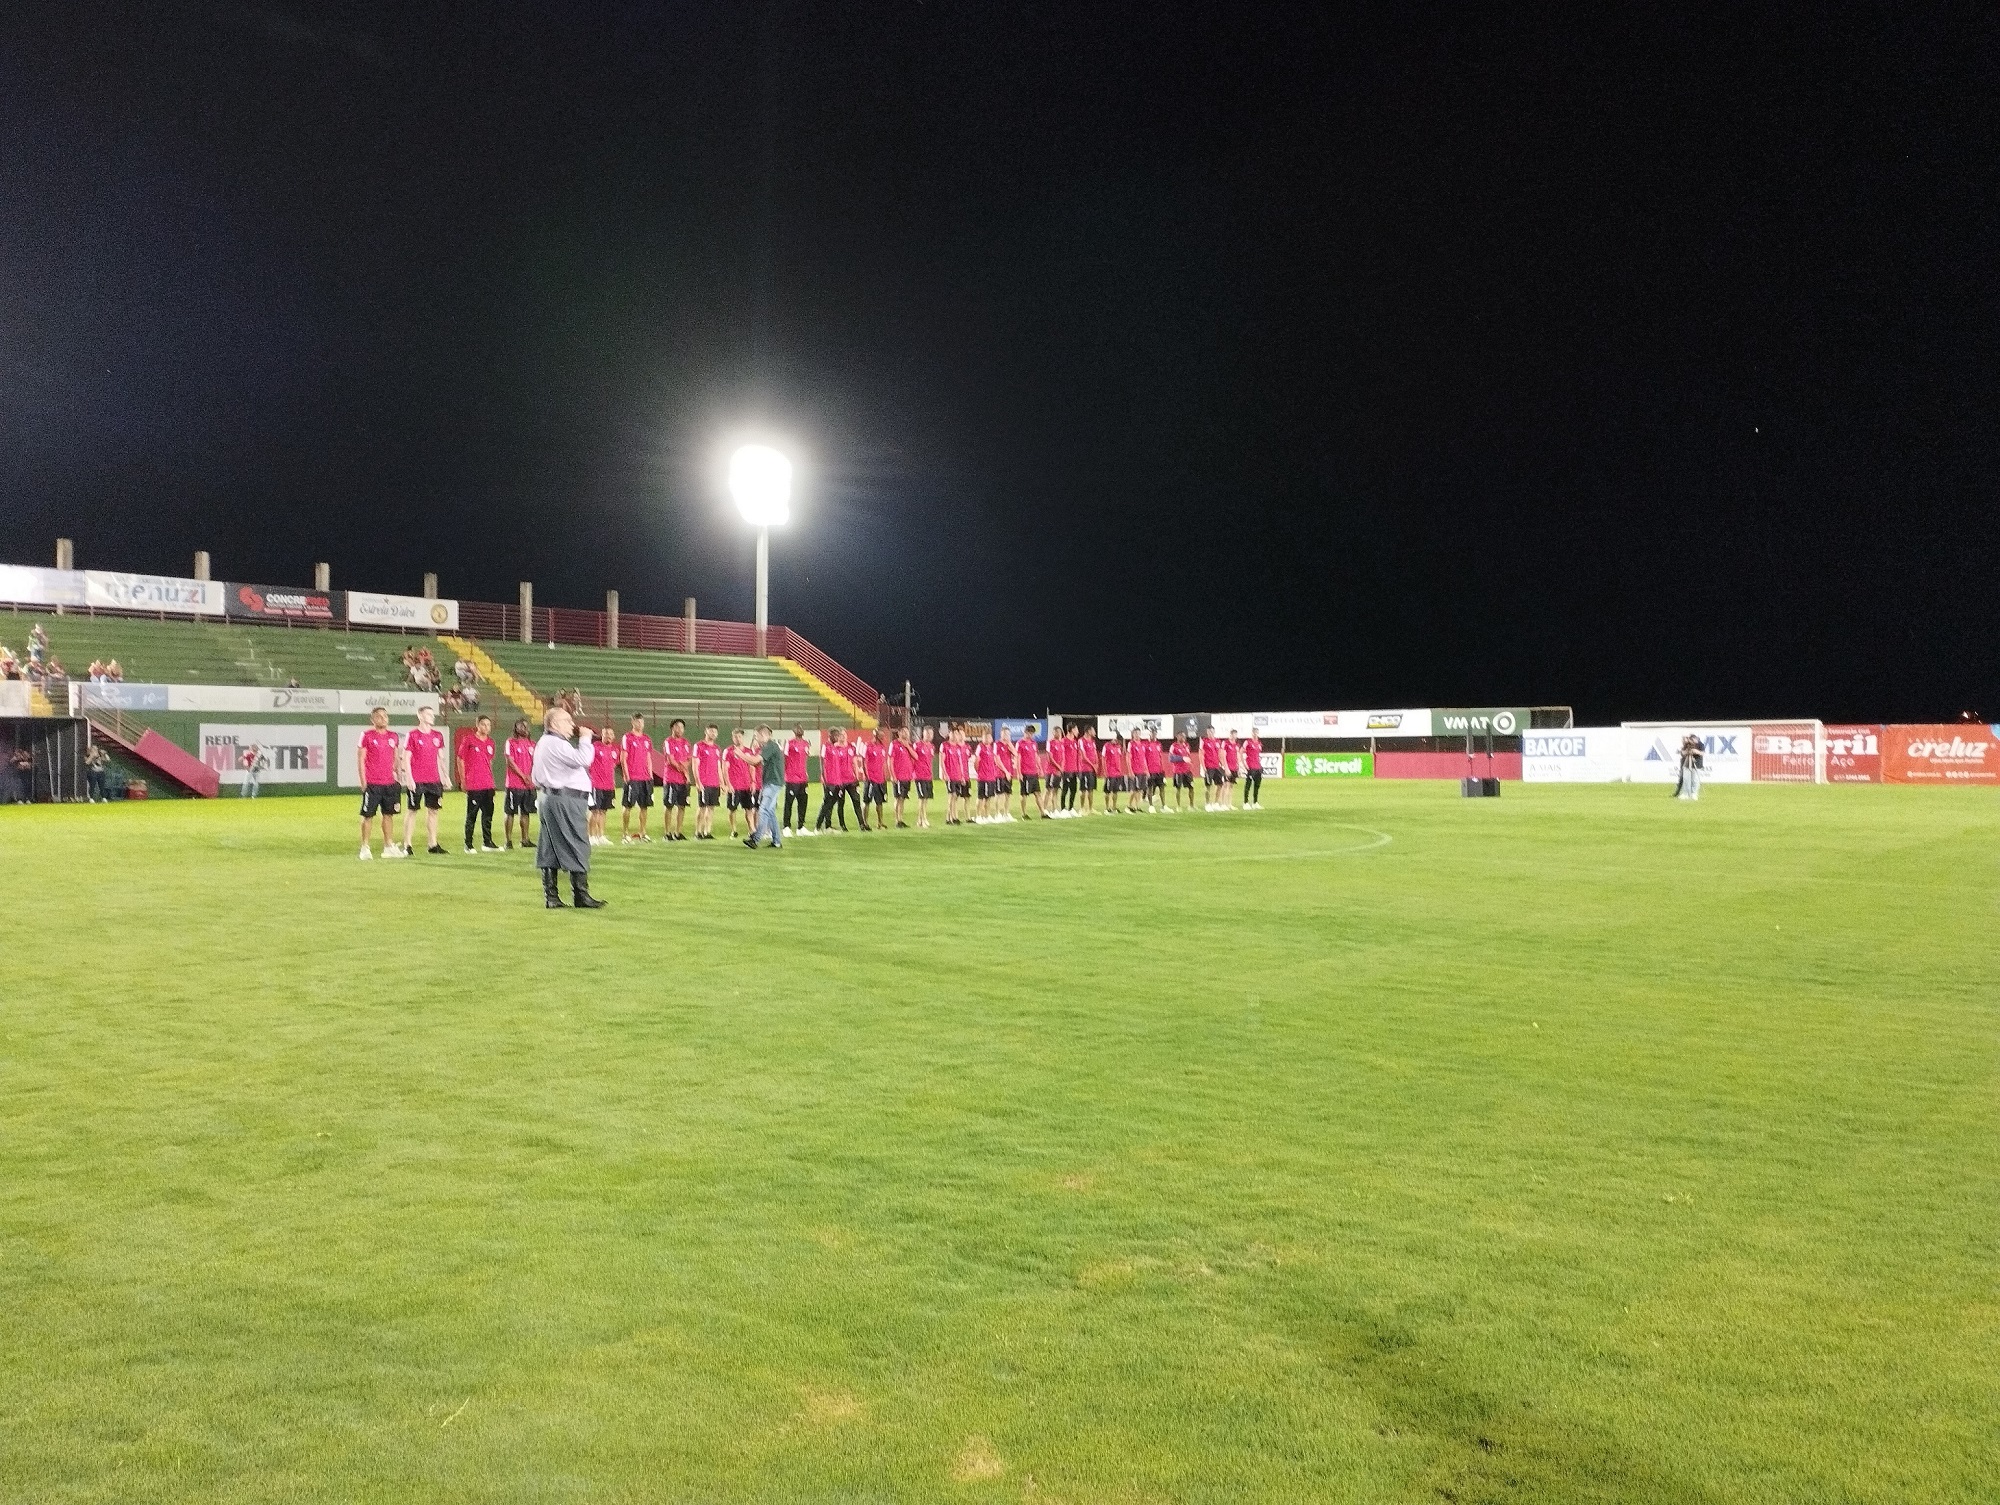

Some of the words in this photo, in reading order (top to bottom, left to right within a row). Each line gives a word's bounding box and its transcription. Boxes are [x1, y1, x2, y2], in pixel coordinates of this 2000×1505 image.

[205, 735, 239, 746] REDE
[1525, 738, 1584, 756] BAKOF
[1907, 736, 1989, 758] creluz
[205, 745, 325, 770] METRE
[1313, 757, 1363, 774] Sicredi
